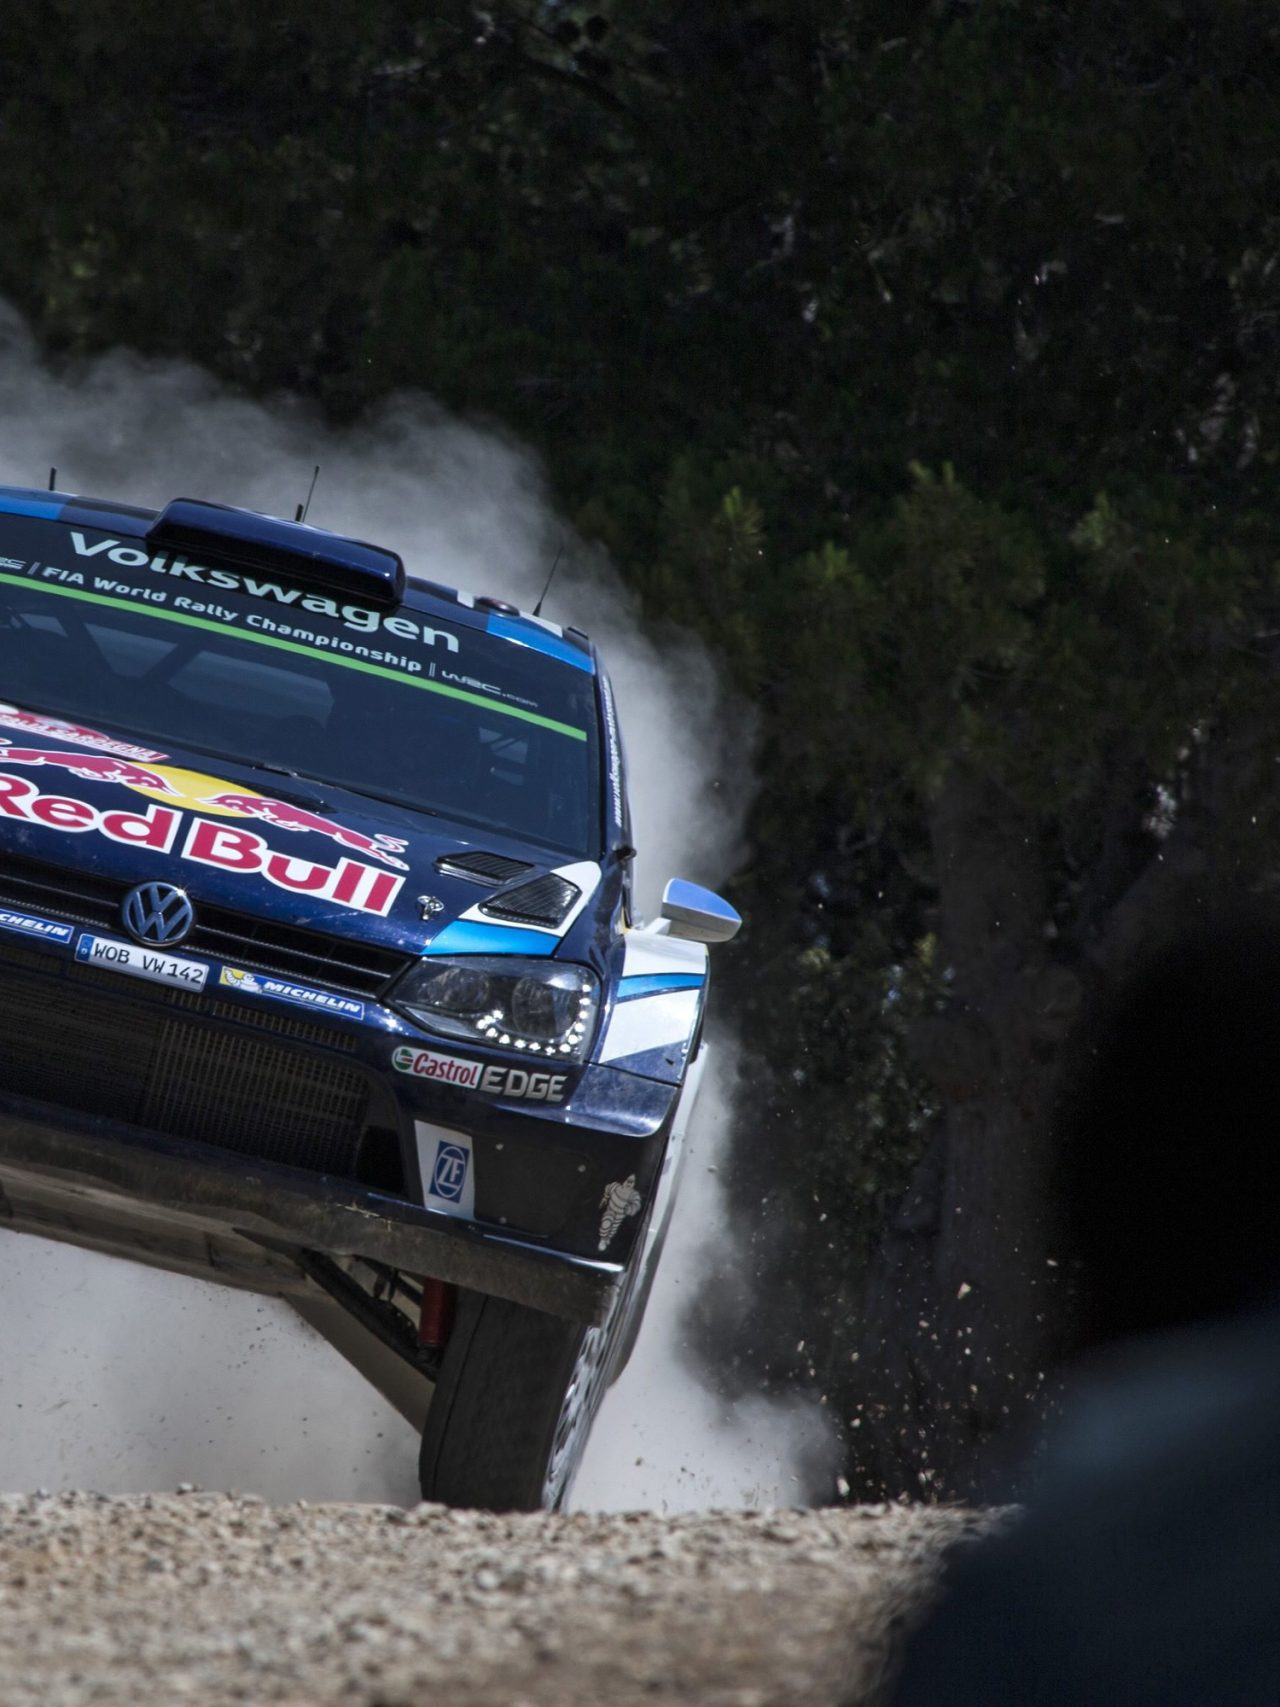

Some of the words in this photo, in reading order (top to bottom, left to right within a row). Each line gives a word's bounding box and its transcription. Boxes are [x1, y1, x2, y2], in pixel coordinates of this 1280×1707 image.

[42, 566, 85, 585] FIA
[94, 576, 168, 603] World
[173, 596, 238, 622] Rally
[246, 614, 423, 672] Championship
[70, 531, 459, 653] Volkswagen
[181, 817, 406, 916] Bull
[94, 942, 131, 964] WOB
[263, 981, 361, 1013] MICHELIN
[412, 1052, 480, 1087] Castrol
[479, 1065, 568, 1102] EDGE
